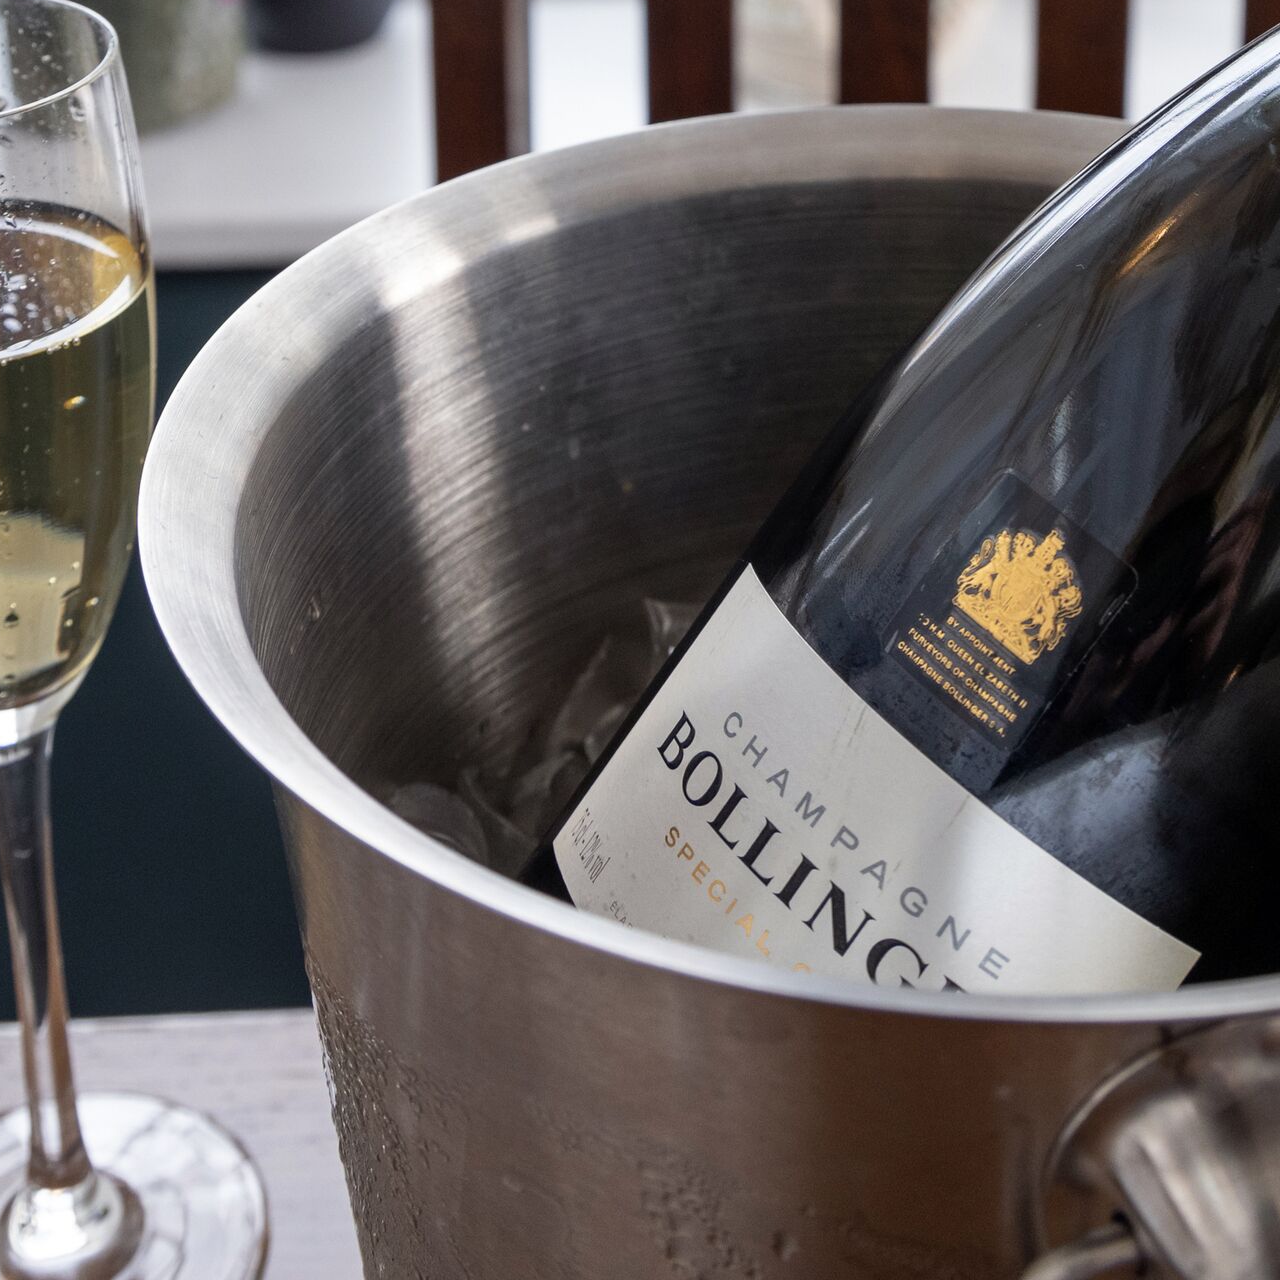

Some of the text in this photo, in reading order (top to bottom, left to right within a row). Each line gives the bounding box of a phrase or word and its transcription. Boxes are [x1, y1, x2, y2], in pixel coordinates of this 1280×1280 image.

[946, 616, 960, 629] BY
[897, 640, 944, 685] CHAMPAGNE
[942, 681, 989, 723] BOLLINGER
[907, 627, 954, 670] PURVEYORS
[952, 667, 967, 680] OF
[964, 677, 1018, 723] CHAMPAGNE
[947, 639, 975, 666] QUEEN
[974, 662, 1020, 703] ELZABETH
[658, 710, 968, 994] BOLLING
[664, 825, 771, 957] SPECIAL
[723, 710, 1011, 980] CHAMPAGNE
